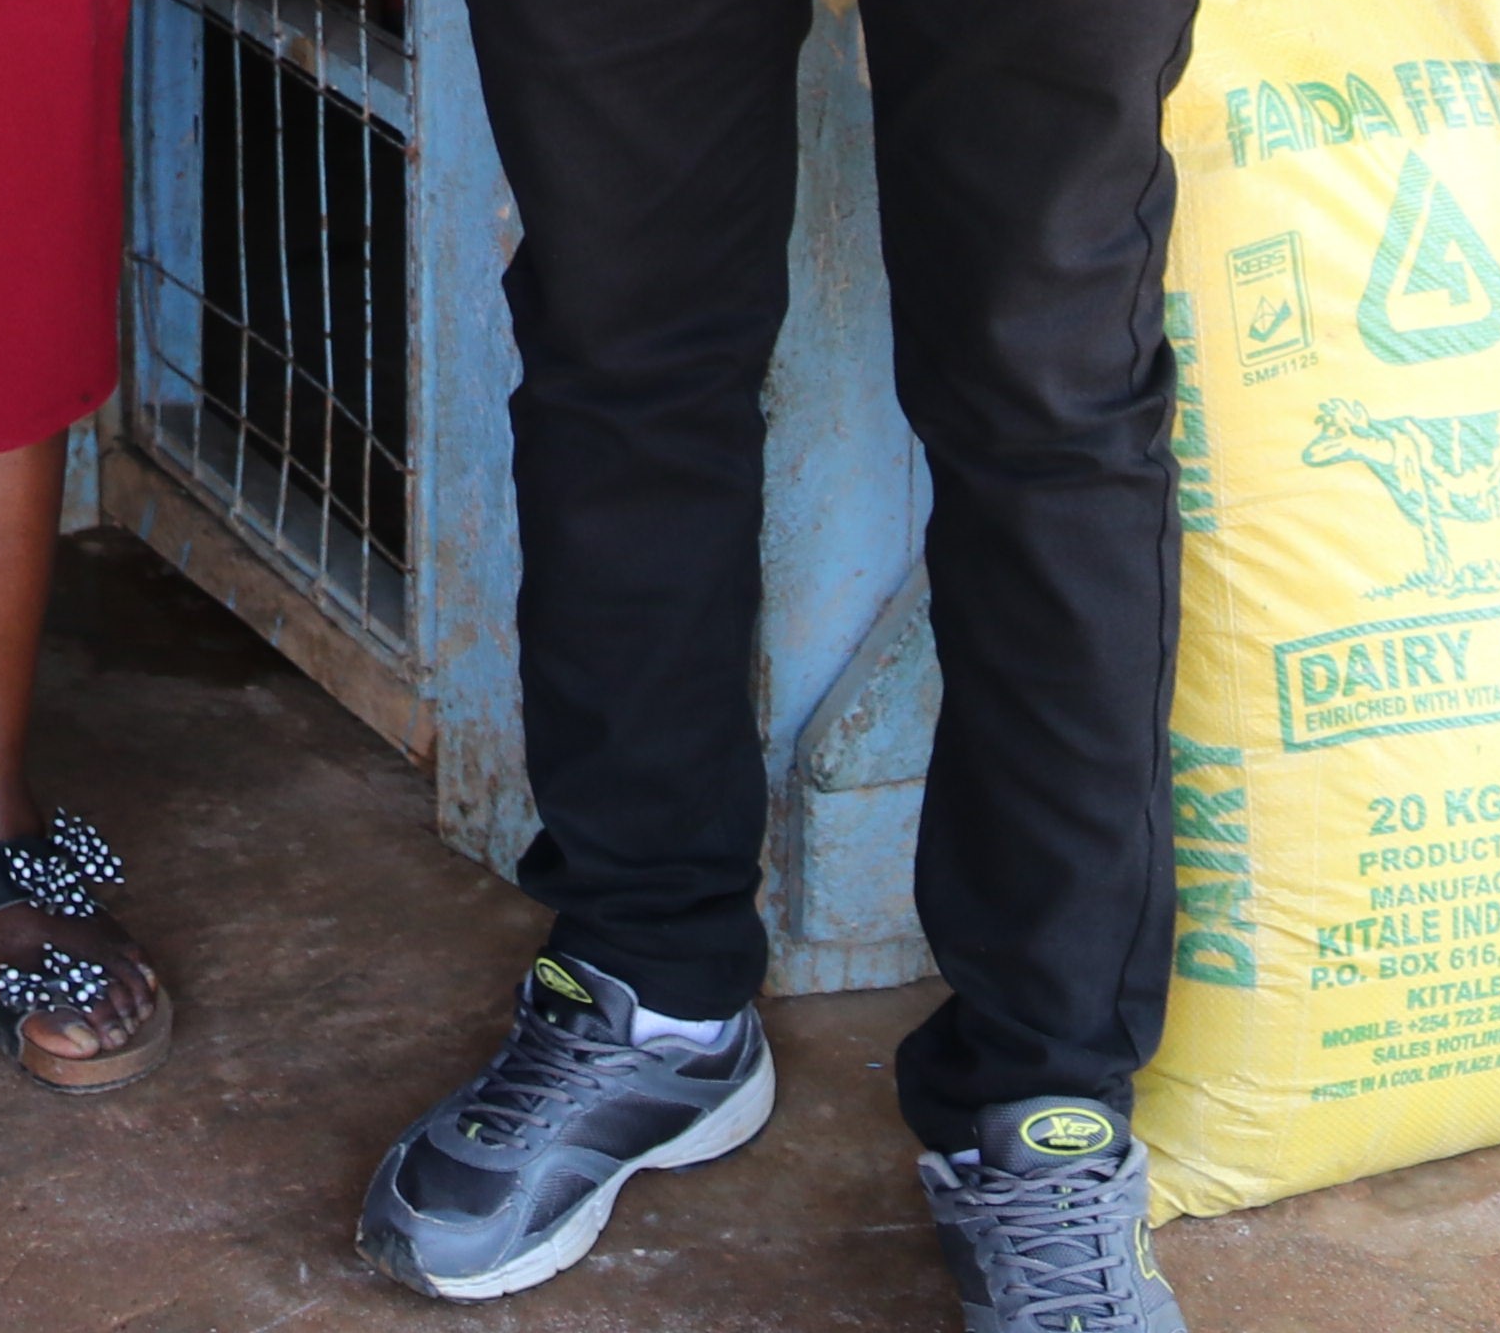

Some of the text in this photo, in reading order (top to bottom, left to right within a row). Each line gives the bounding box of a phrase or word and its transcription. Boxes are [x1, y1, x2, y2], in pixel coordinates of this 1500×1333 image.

[1232, 249, 1287, 278] KEBS
[1242, 351, 1320, 387] SM#1125
[1299, 628, 1472, 708] DAIRY
[1304, 696, 1408, 733] ENRICHED
[1412, 689, 1460, 715] WITH
[1368, 792, 1428, 837] 20
[1168, 730, 1259, 989] DAIRY
[1316, 909, 1442, 961] KITALE
[1309, 962, 1368, 991] P.O.
[1378, 952, 1440, 980] BOX
[1321, 1018, 1403, 1050] MOBILE:
[1407, 1012, 1450, 1035] +254
[1454, 1007, 1485, 1030] 722
[1372, 1041, 1431, 1066] SALES
